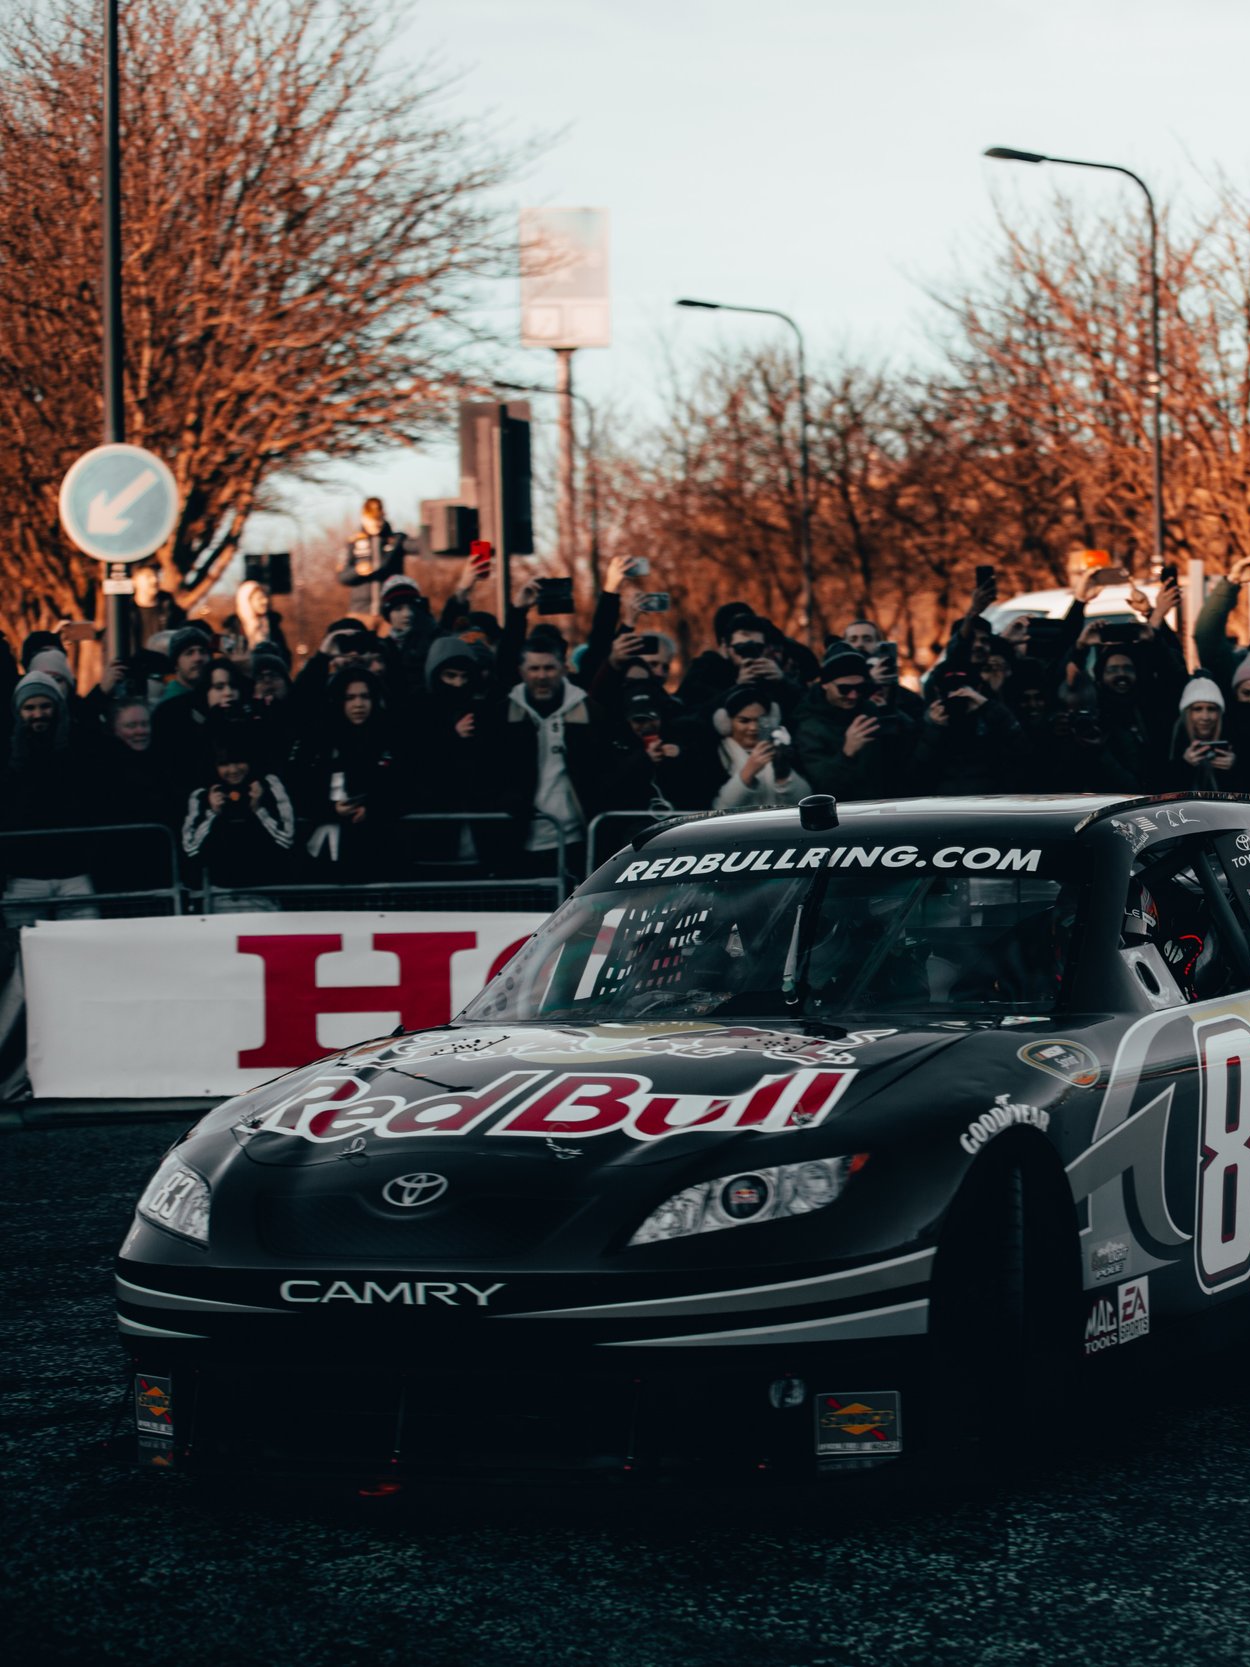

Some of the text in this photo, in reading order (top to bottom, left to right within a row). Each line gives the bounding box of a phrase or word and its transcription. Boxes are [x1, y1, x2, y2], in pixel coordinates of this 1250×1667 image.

[614, 846, 1042, 883] REDBULLRING.COM
[258, 1069, 857, 1142] Red Bull
[959, 1101, 1050, 1155] GOODYEAR
[148, 1169, 198, 1220] 83
[280, 1280, 507, 1306] CAMRY
[1121, 1285, 1147, 1323] EA
[1084, 1332, 1118, 1355] TOOLS
